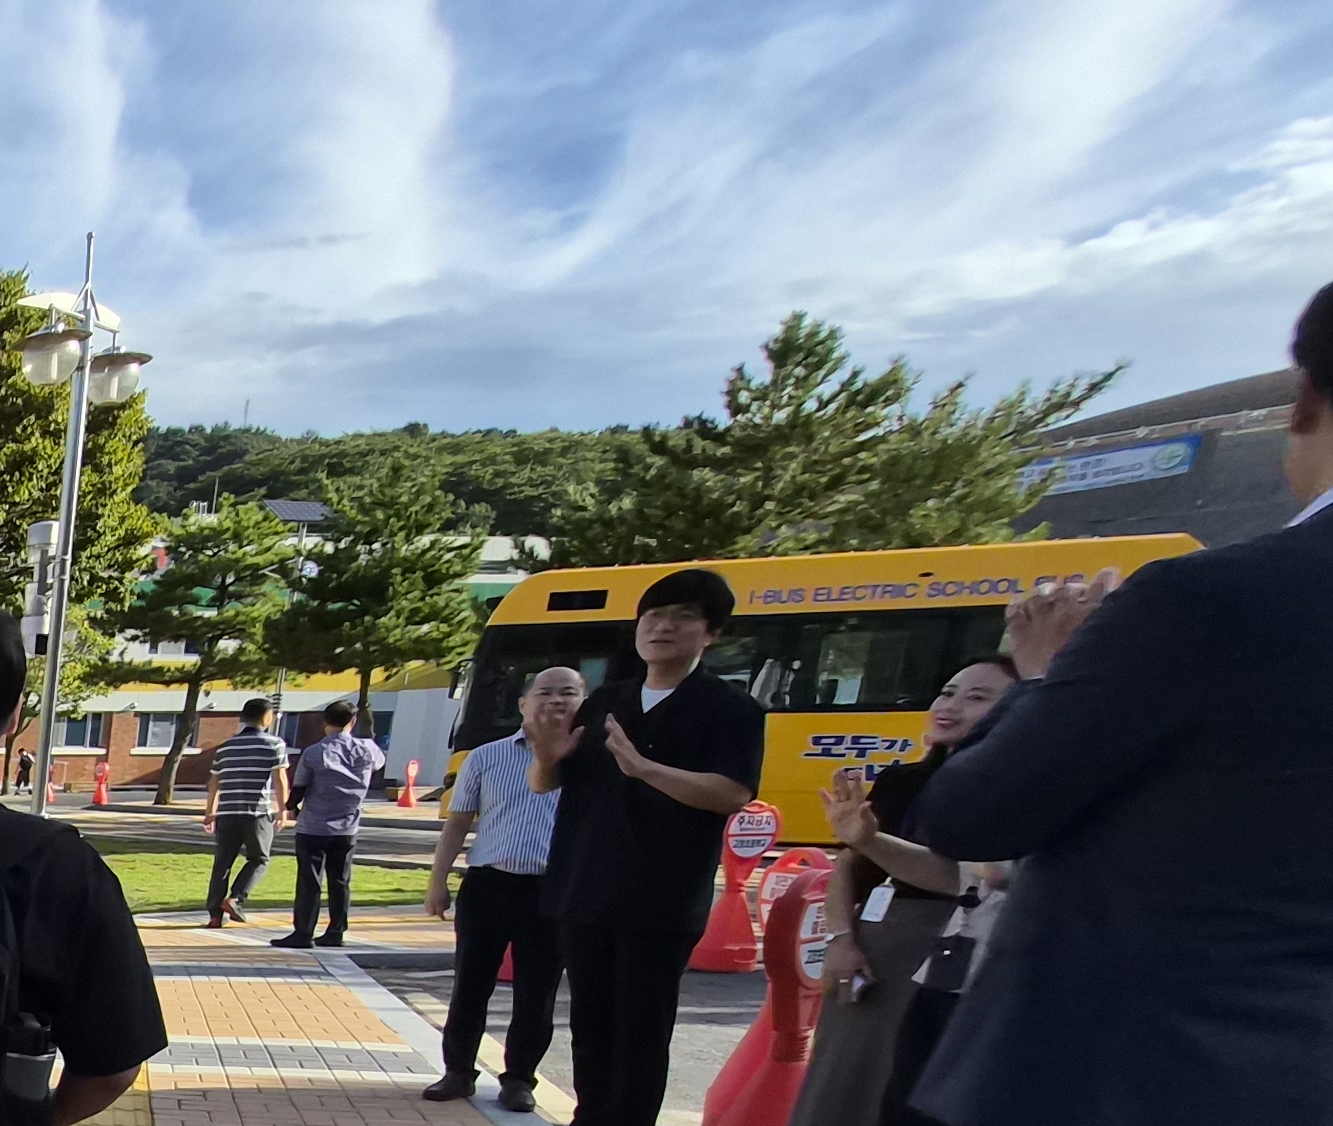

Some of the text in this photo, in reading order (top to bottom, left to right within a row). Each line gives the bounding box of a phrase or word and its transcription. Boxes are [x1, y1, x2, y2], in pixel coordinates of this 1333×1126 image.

[749, 588, 805, 604] I-BUS
[813, 583, 919, 603] ELECTRIC
[927, 578, 1025, 598] SCHOOL
[803, 735, 913, 758] 모두가
